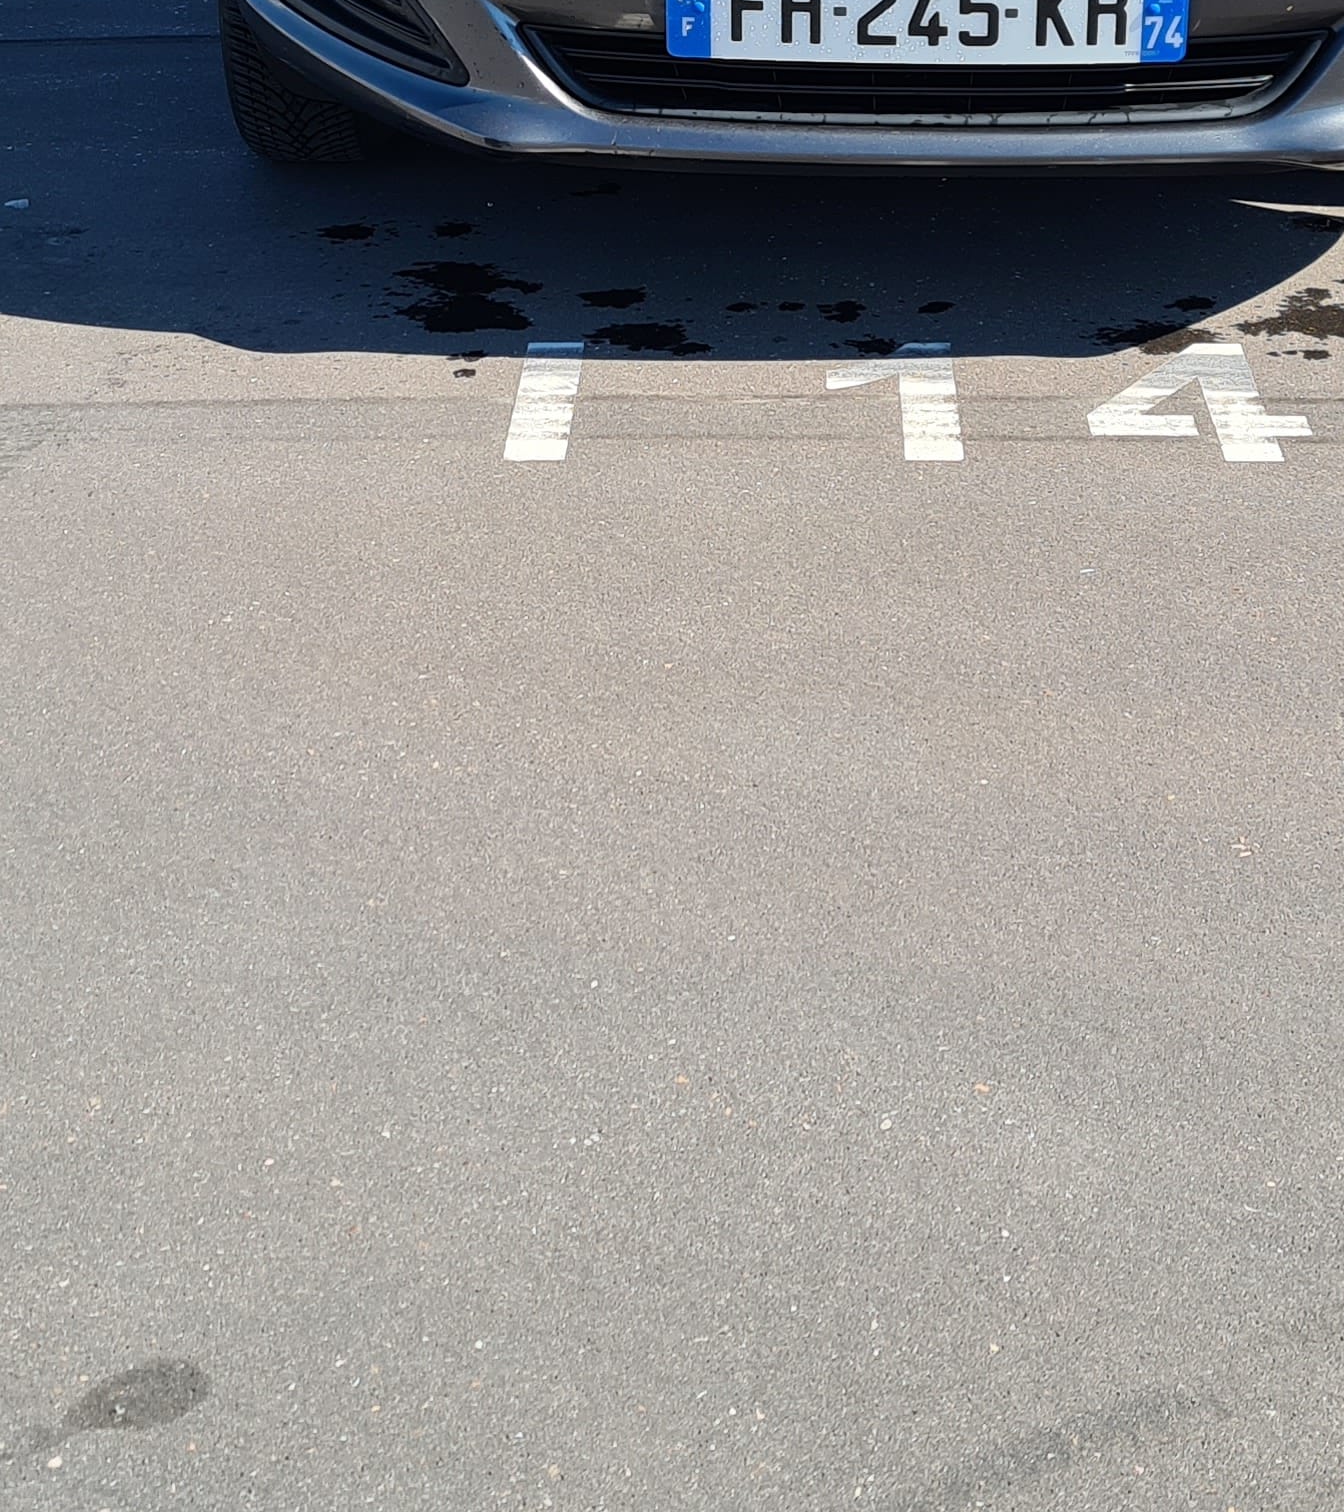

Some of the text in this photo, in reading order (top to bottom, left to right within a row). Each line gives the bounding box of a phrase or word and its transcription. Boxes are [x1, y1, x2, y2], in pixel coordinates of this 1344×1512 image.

[681, 17, 695, 37] F
[1144, 16, 1183, 49] 74
[502, 341, 1312, 461] 114
